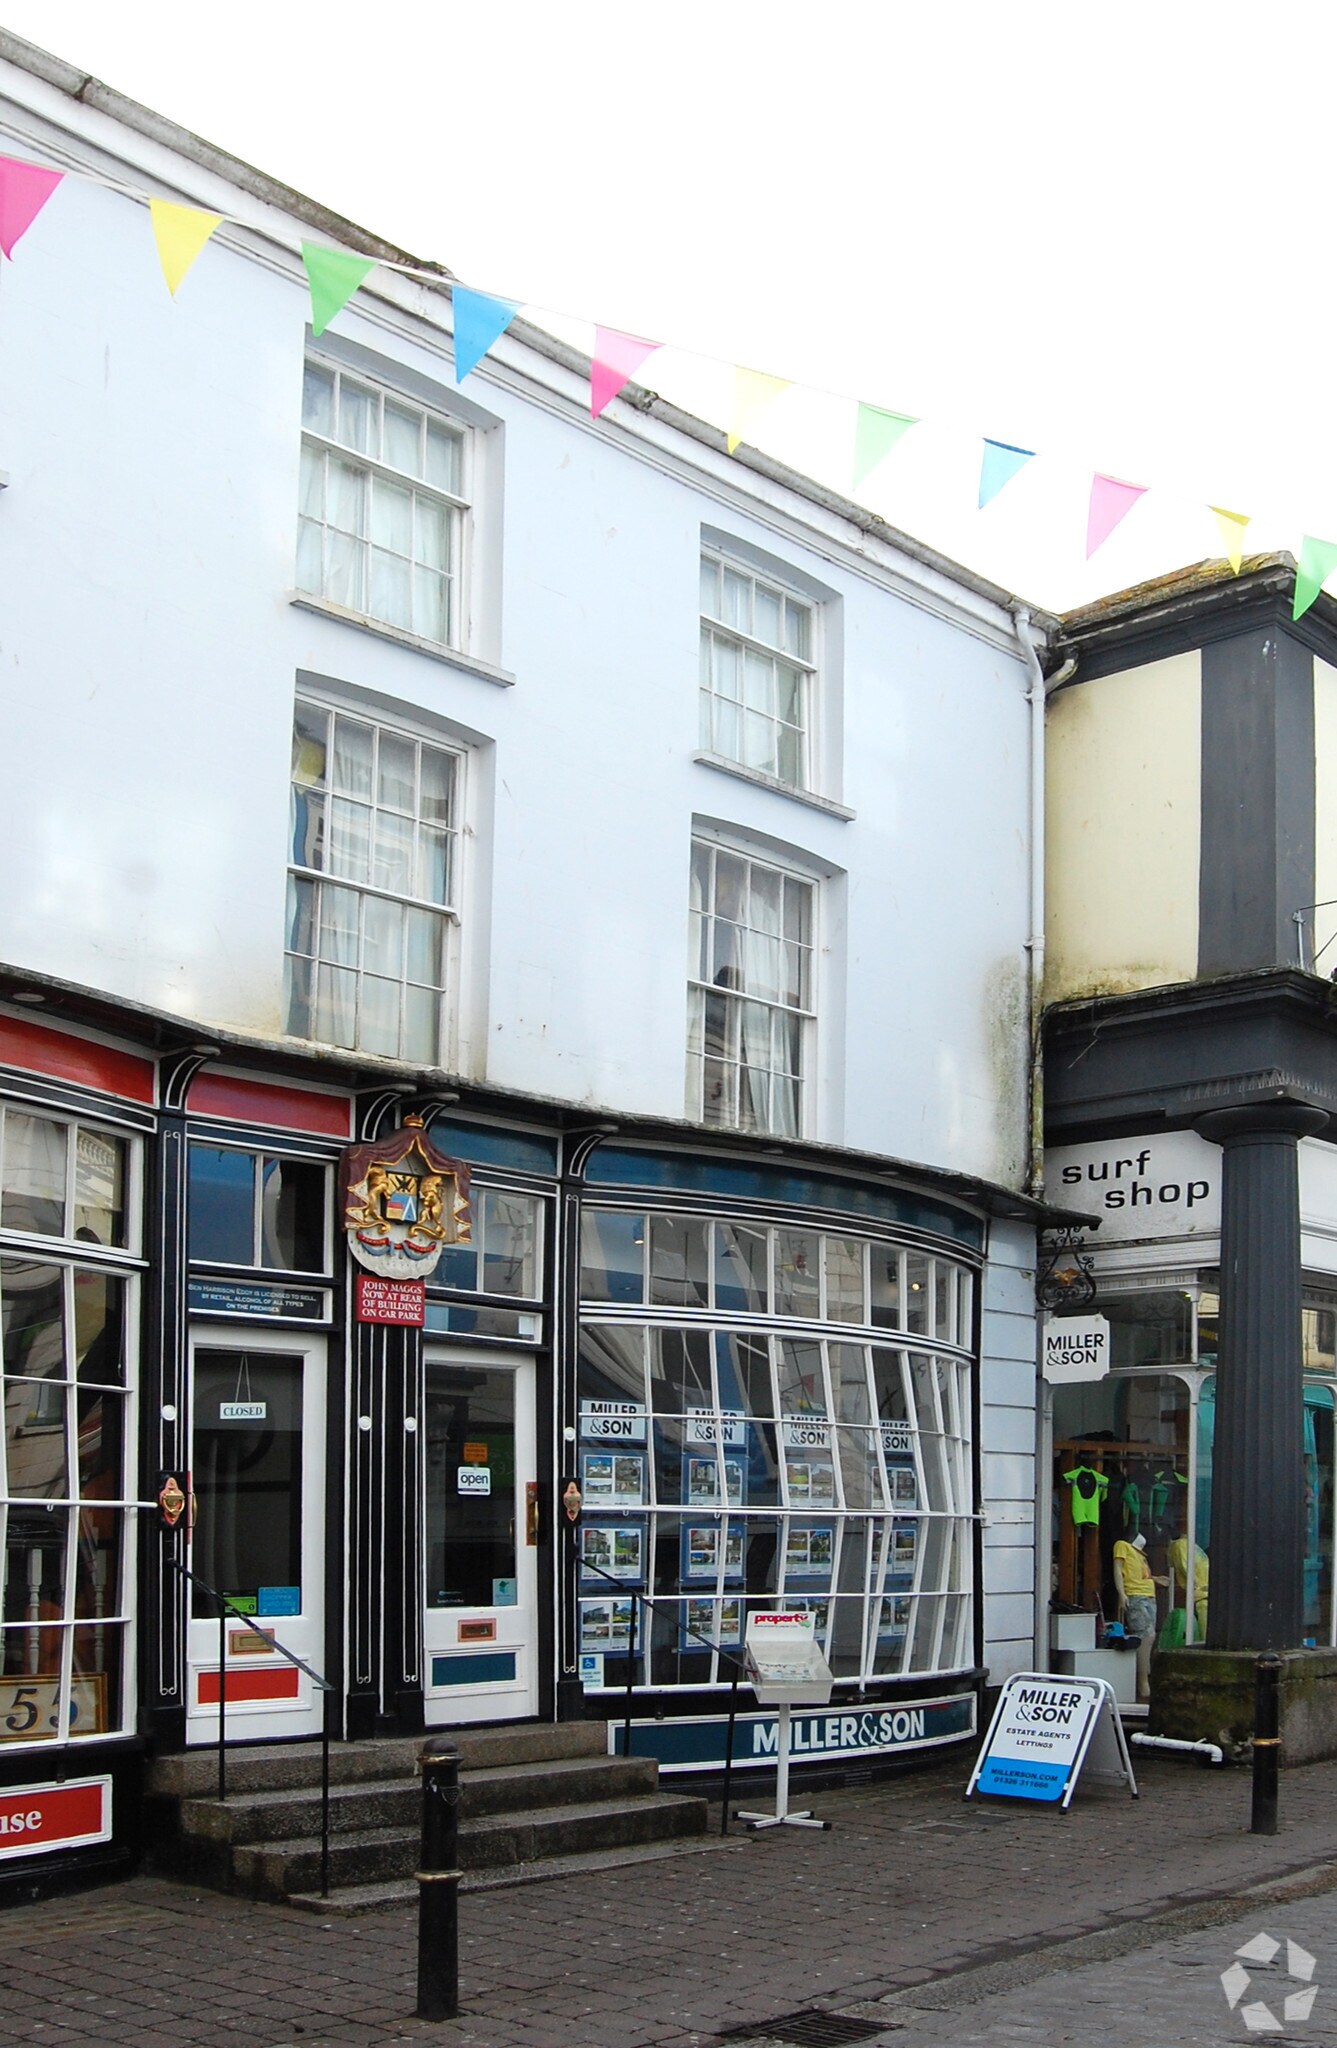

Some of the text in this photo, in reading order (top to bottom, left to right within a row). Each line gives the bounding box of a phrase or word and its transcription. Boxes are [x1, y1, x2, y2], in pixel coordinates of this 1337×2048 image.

[1062, 1150, 1151, 1184] surf
[1105, 1181, 1209, 1208] shop
[363, 1281, 422, 1294] JOHN MAGGS
[234, 1296, 262, 1304] ALCOHOL
[261, 1291, 290, 1299] LICENSED
[362, 1288, 422, 1303] NOW AT REAR
[250, 1304, 280, 1312] PREMISES
[362, 1299, 422, 1312] OF BUILDING
[362, 1308, 376, 1317] ON
[378, 1310, 396, 1319] CAR
[1047, 1334, 1104, 1351] MILLER
[1046, 1350, 1097, 1366] &SON
[223, 1407, 263, 1416] CLOSED
[591, 1403, 637, 1419] MILLER
[695, 1410, 737, 1425] MILER
[590, 1418, 632, 1435] &SON
[791, 1430, 825, 1445] &SON
[883, 1436, 909, 1449] SON
[461, 1475, 489, 1486] open
[755, 1613, 809, 1625] property
[1018, 1689, 1082, 1708] MILLER
[1016, 1704, 1072, 1724] &SON
[1006, 1728, 1071, 1740] ESTATE AGENTS
[1016, 1740, 1053, 1749] LETTINGS
[991, 1768, 1058, 1781] MILLERSON.COM
